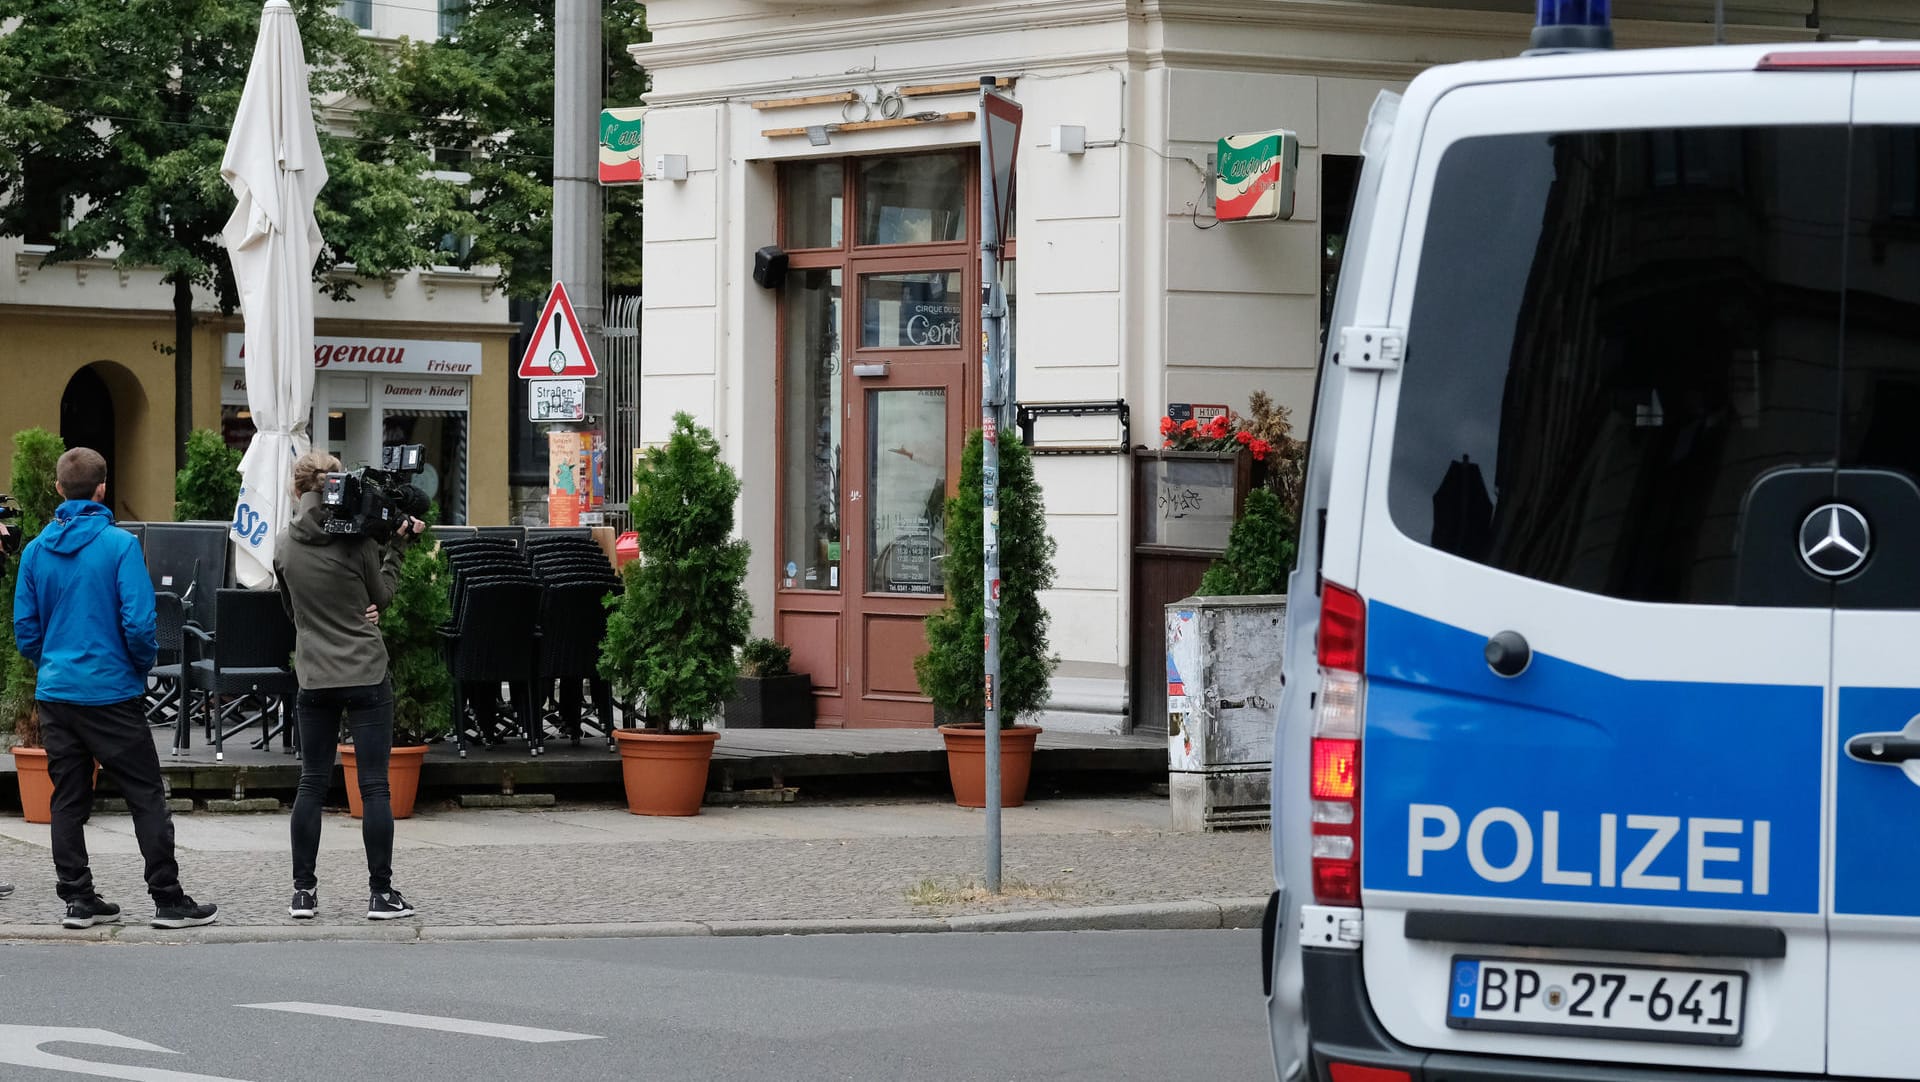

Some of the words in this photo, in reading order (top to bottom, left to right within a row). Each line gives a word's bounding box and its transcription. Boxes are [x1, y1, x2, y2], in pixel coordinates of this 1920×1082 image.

[915, 305, 943, 314] CIRQUE
[427, 359, 472, 373] Friseur
[384, 384, 422, 395] Damen
[428, 385, 465, 397] Kinder
[1169, 408, 1175, 416] S
[1407, 803, 1771, 895] POLIZEI
[1458, 993, 1469, 1007] D
[1480, 967, 1541, 1013] BP
[1568, 972, 1733, 1027] 27-641
